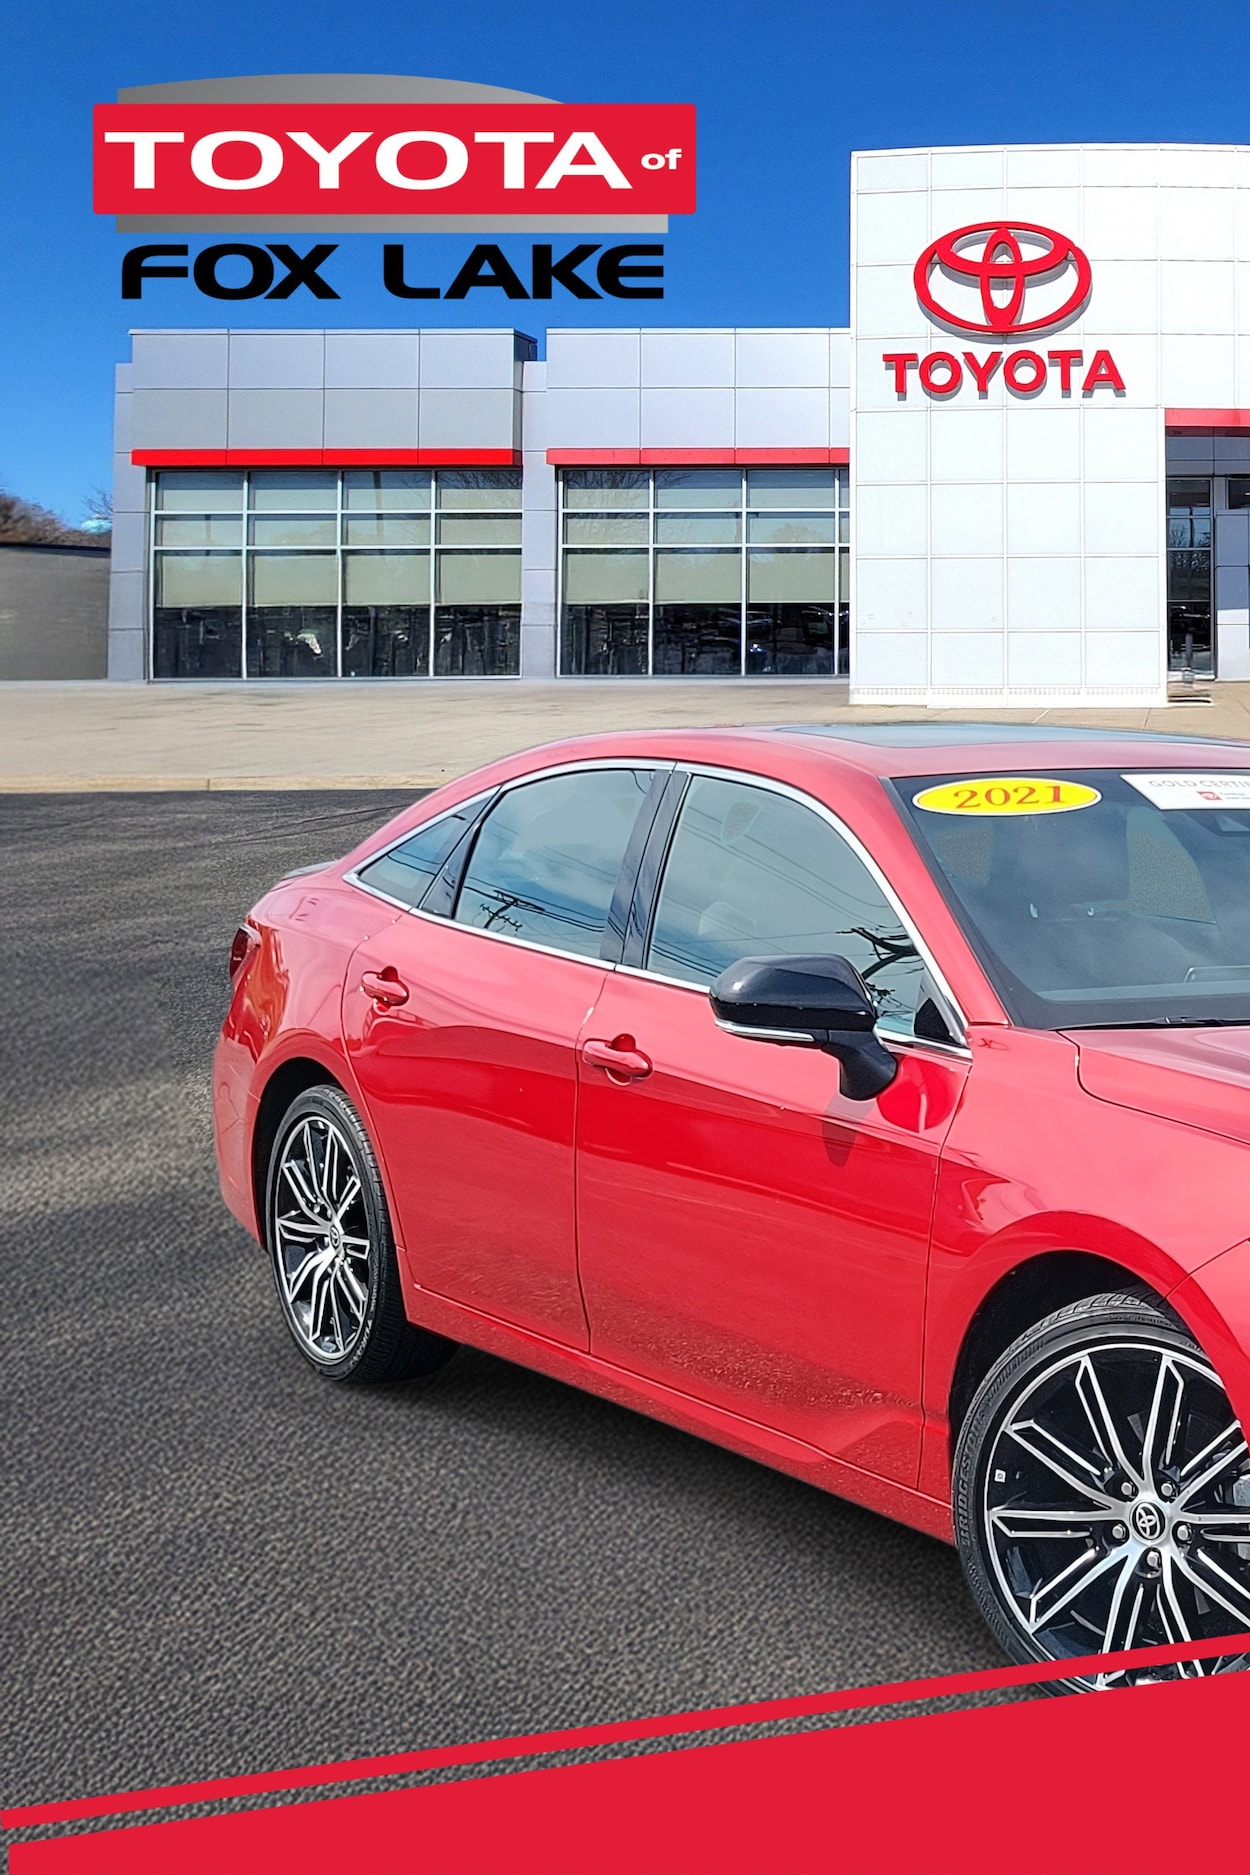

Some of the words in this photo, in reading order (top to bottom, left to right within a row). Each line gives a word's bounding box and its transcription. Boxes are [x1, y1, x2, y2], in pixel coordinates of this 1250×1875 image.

[882, 349, 1126, 398] TOYOTA
[1149, 780, 1197, 788] GOLD
[954, 785, 1069, 810] 2021
